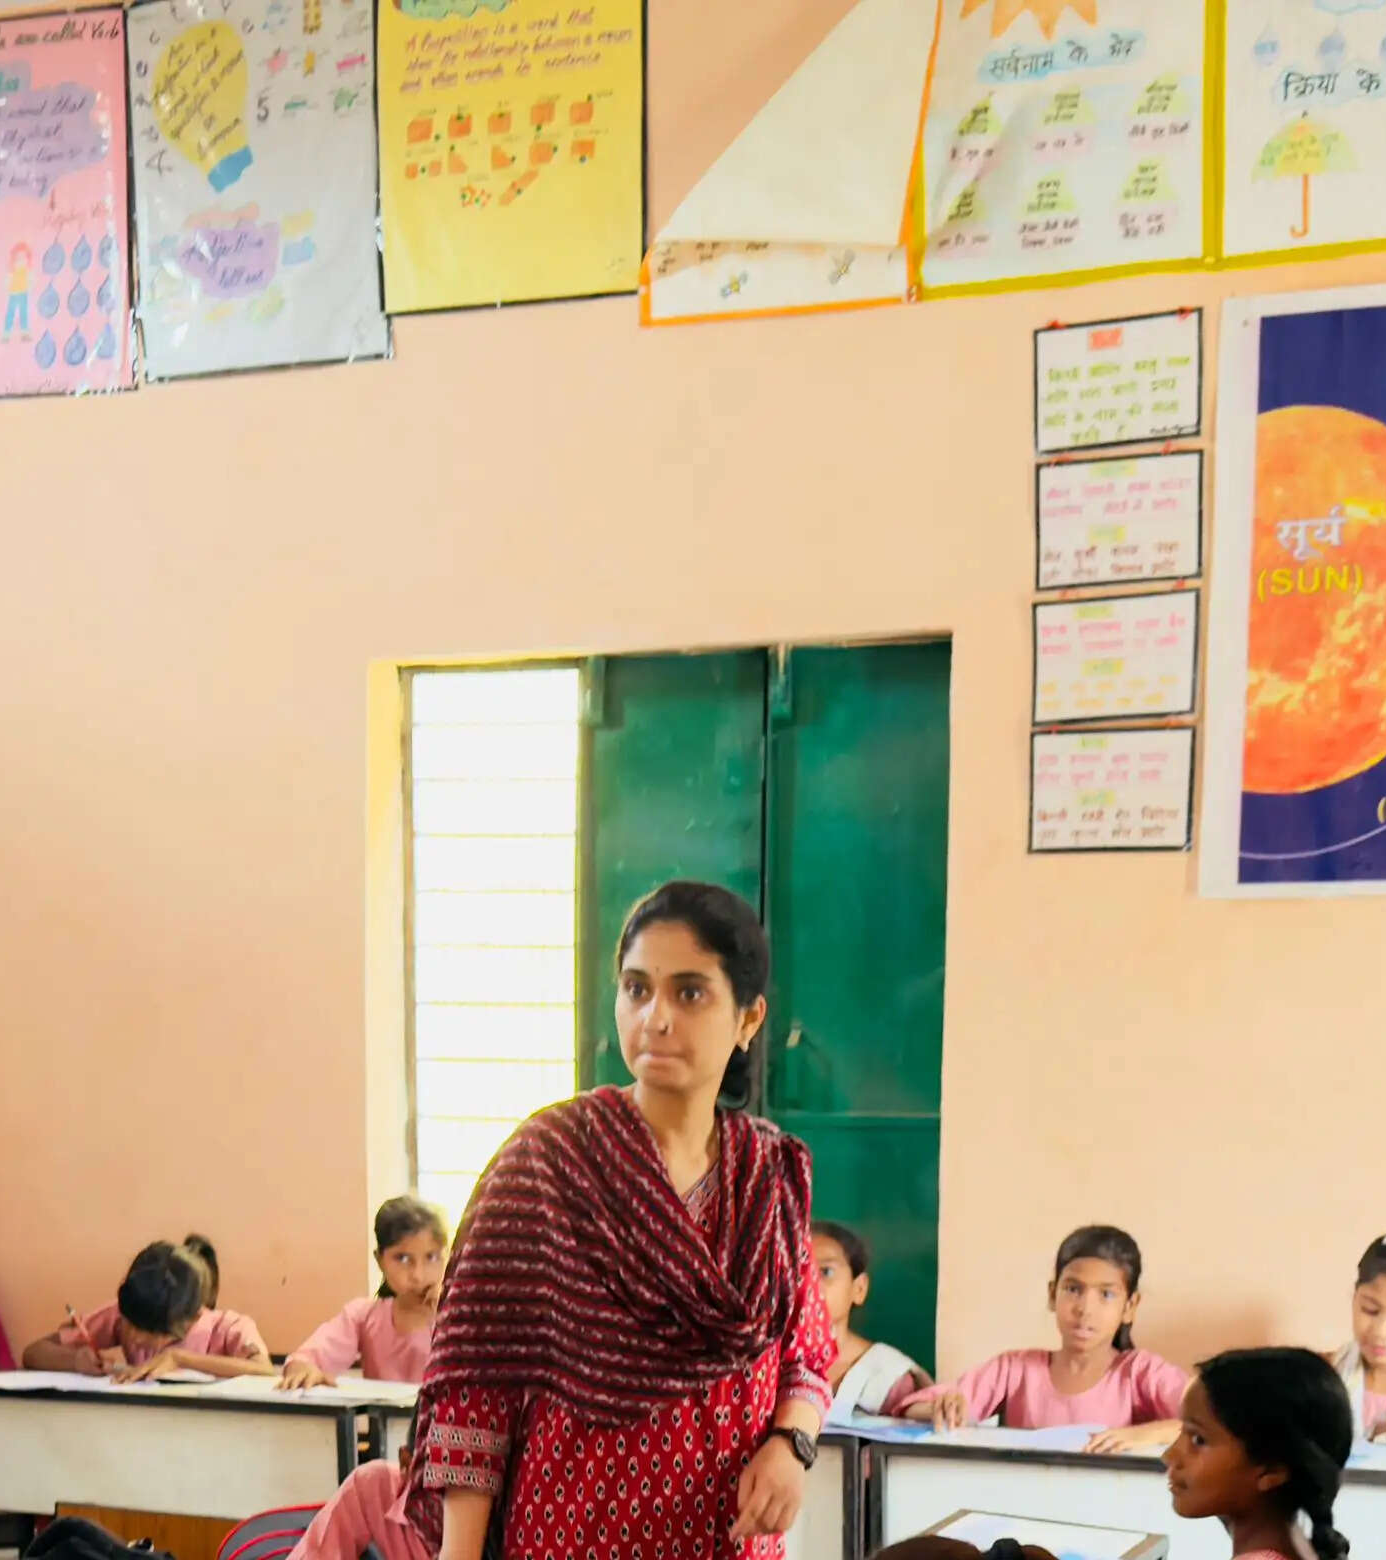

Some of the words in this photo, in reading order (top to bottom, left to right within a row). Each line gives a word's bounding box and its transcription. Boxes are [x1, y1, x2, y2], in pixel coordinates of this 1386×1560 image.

[1356, 67, 1381, 94] के
[1276, 503, 1346, 561] सूर्य
[1257, 564, 1363, 603] (SUN)
